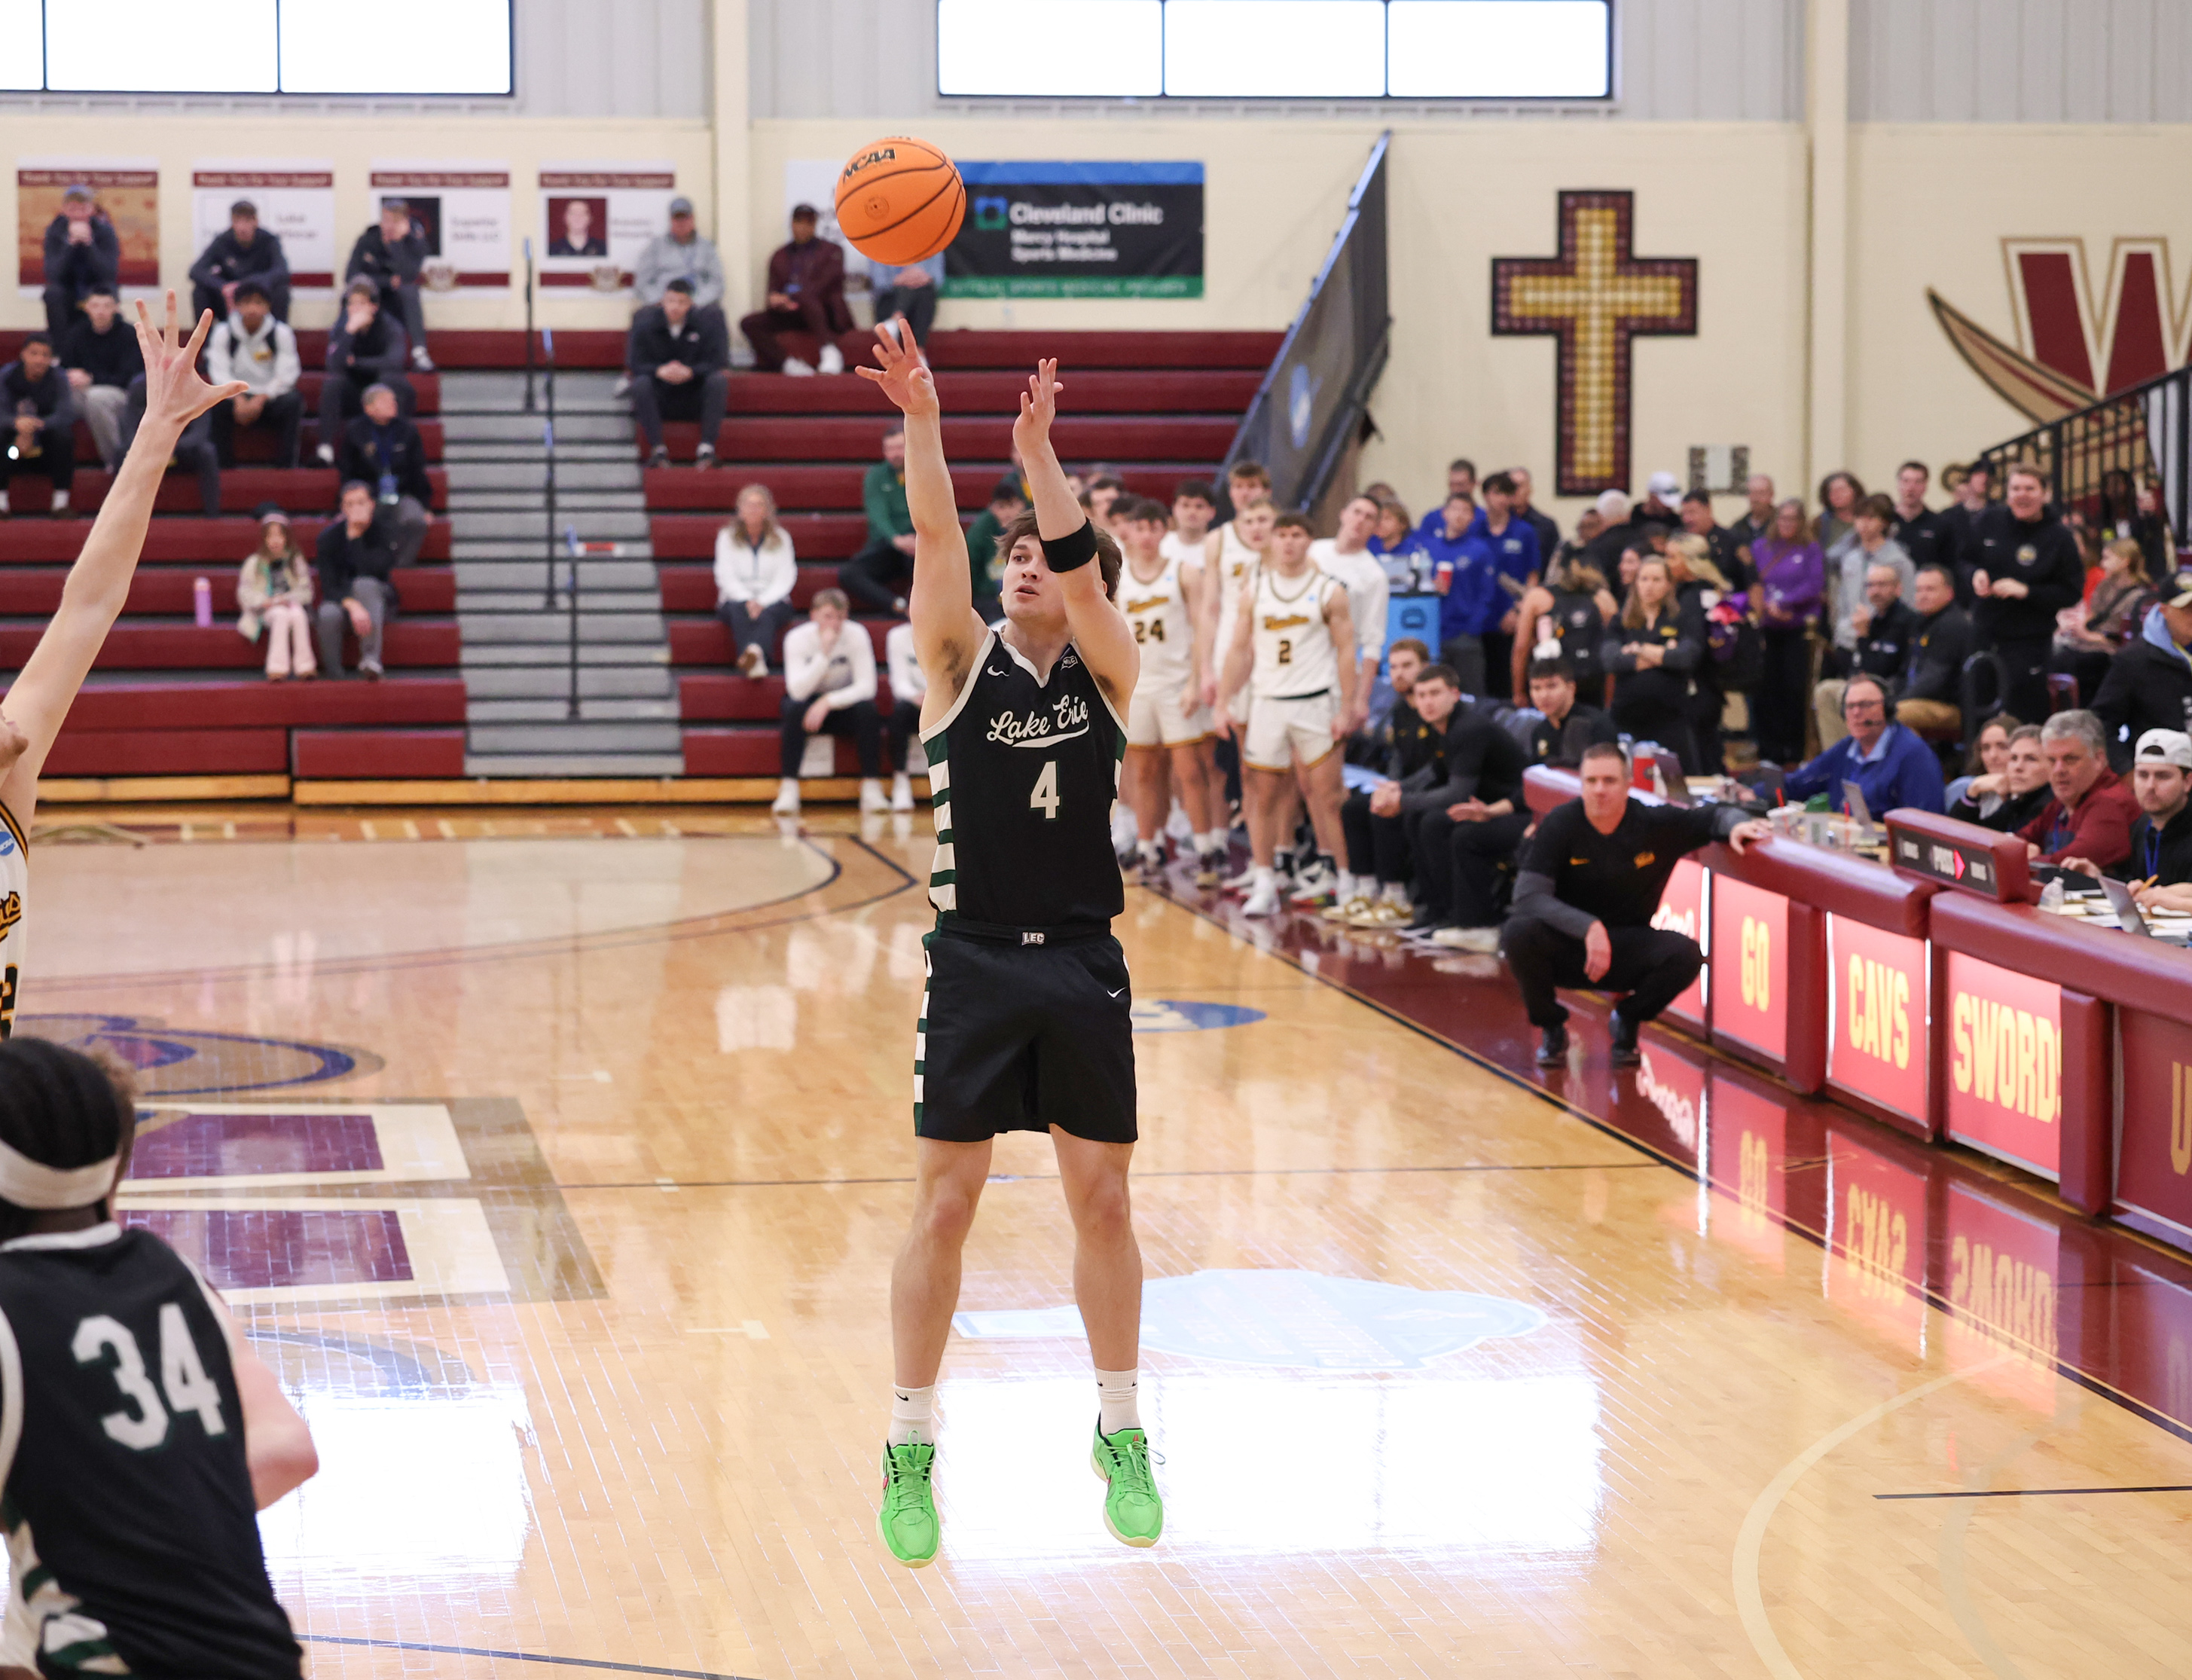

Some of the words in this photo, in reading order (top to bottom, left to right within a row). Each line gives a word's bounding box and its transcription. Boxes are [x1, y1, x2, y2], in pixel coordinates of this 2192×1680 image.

[843, 148, 895, 184] NCAA
[1009, 202, 1107, 225] Cleveland
[1108, 202, 1163, 225] Clinic
[1056, 229, 1110, 247] Hospital
[1057, 247, 1118, 261] Medicine
[1134, 619, 1165, 644] 24
[1279, 640, 1291, 664] 2
[986, 710, 1051, 745] Lake
[1052, 694, 1089, 729] Erie
[1030, 760, 1060, 820] 4
[1021, 932, 1045, 945] LEC
[1741, 915, 1769, 1013] GO
[1848, 953, 1910, 1071] CAVS
[72, 1303, 226, 1450] 34
